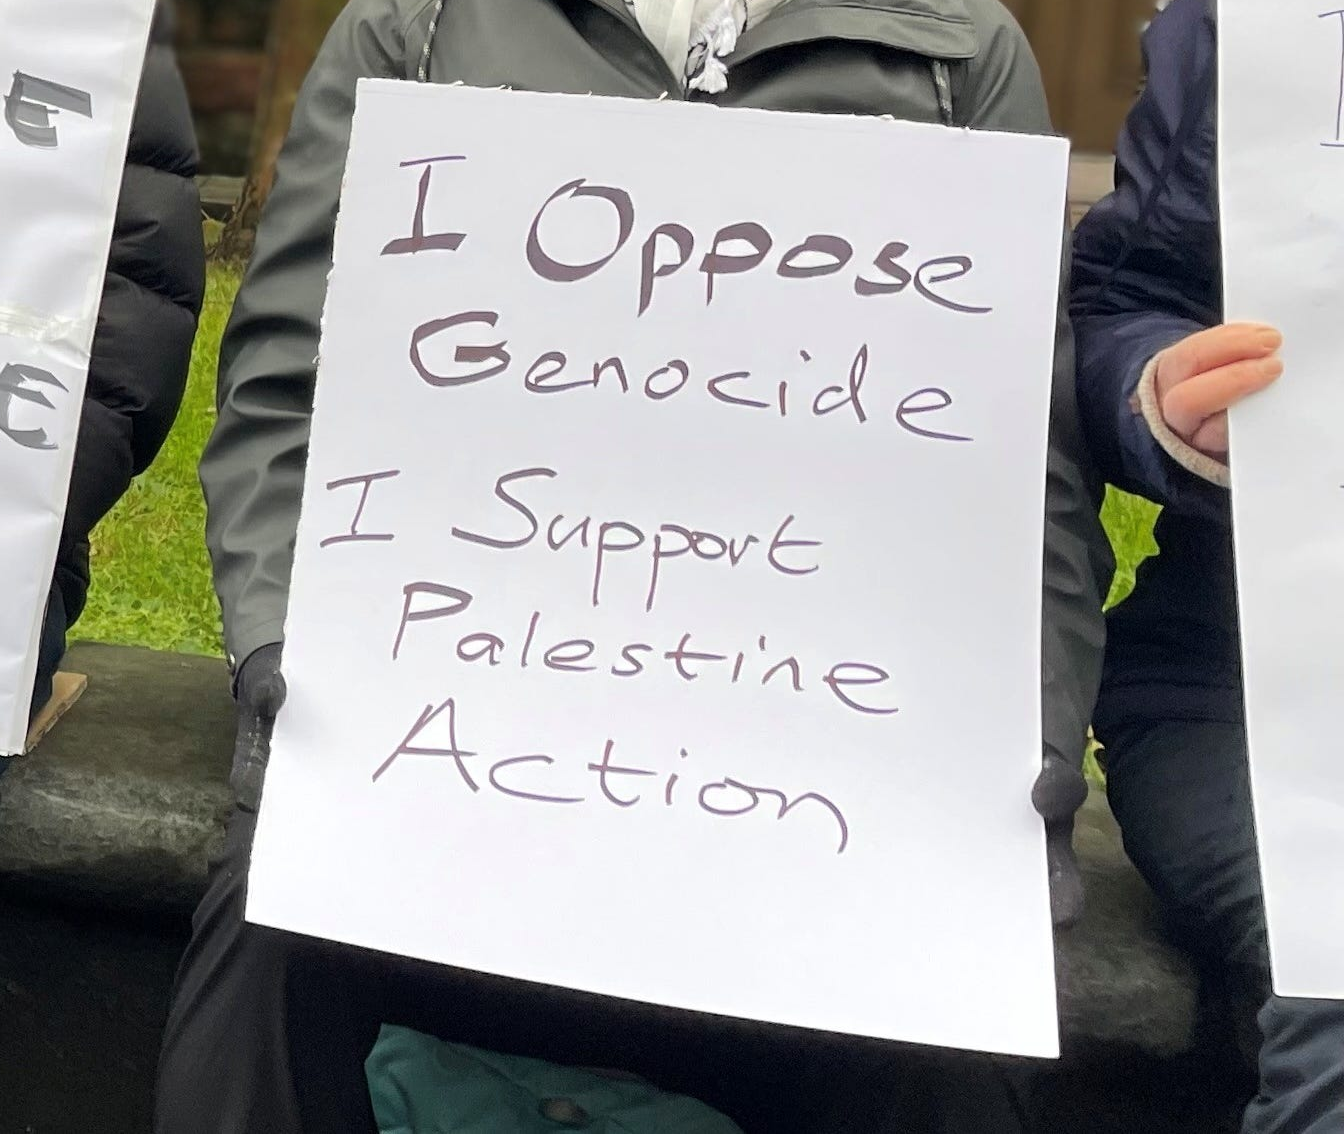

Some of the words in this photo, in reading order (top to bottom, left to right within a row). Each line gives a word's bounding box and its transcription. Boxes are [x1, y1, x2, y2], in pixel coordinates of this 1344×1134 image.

[379, 153, 468, 257] I
[524, 178, 993, 318] Oppose
[407, 310, 974, 444] Genocide
[318, 469, 403, 547] I
[451, 467, 824, 613] Support
[392, 580, 901, 716] Palestine
[371, 697, 853, 855] Action
